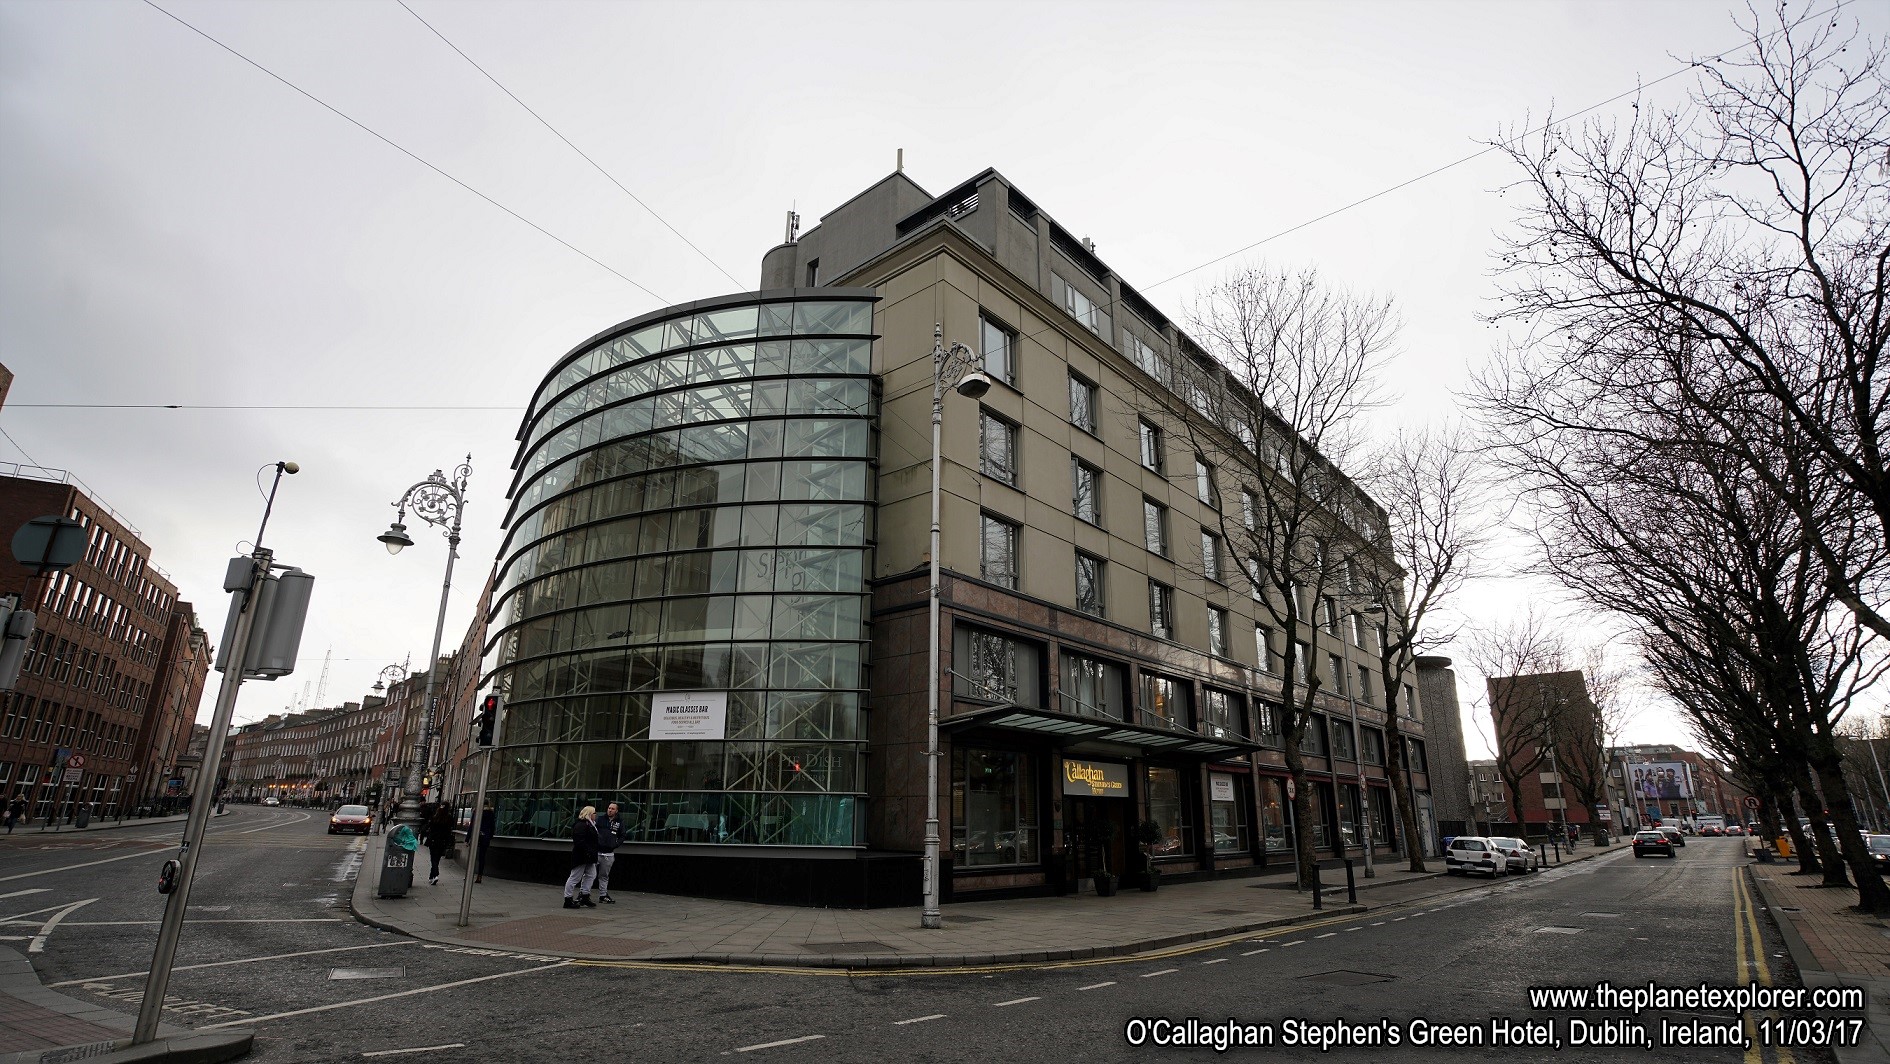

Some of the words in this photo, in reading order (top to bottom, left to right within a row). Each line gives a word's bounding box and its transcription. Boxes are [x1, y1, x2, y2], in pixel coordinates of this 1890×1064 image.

[665, 706, 680, 714] MAGIC
[680, 705, 699, 713] GLASSES
[699, 705, 709, 713] BAR
[805, 753, 842, 768] DISH
